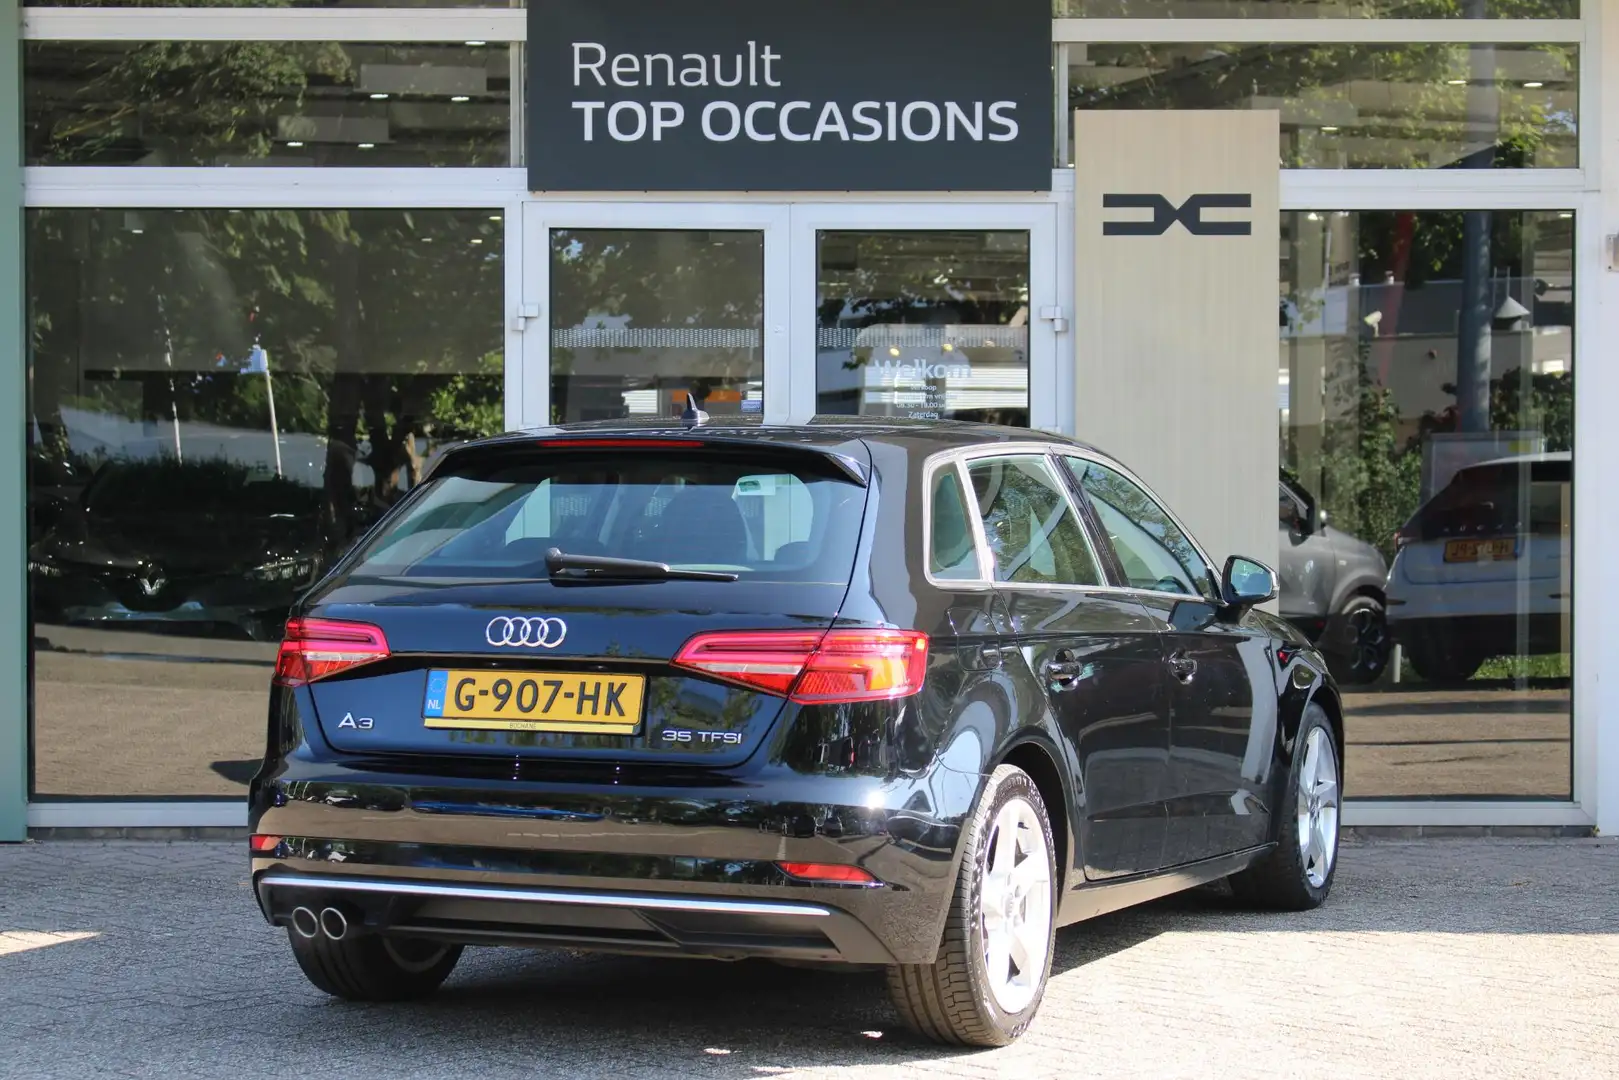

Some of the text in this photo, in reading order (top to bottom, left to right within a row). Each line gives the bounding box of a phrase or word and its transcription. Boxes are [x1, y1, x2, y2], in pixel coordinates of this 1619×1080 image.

[572, 41, 781, 87] Renault
[572, 101, 1019, 142] TOP OCCASIONS
[874, 359, 971, 379] Welkom
[908, 411, 939, 420] Zaterdag
[427, 699, 441, 710] NL
[454, 677, 628, 716] G-907-HK
[338, 712, 374, 729] A3
[662, 730, 742, 744] 35 TFSI
